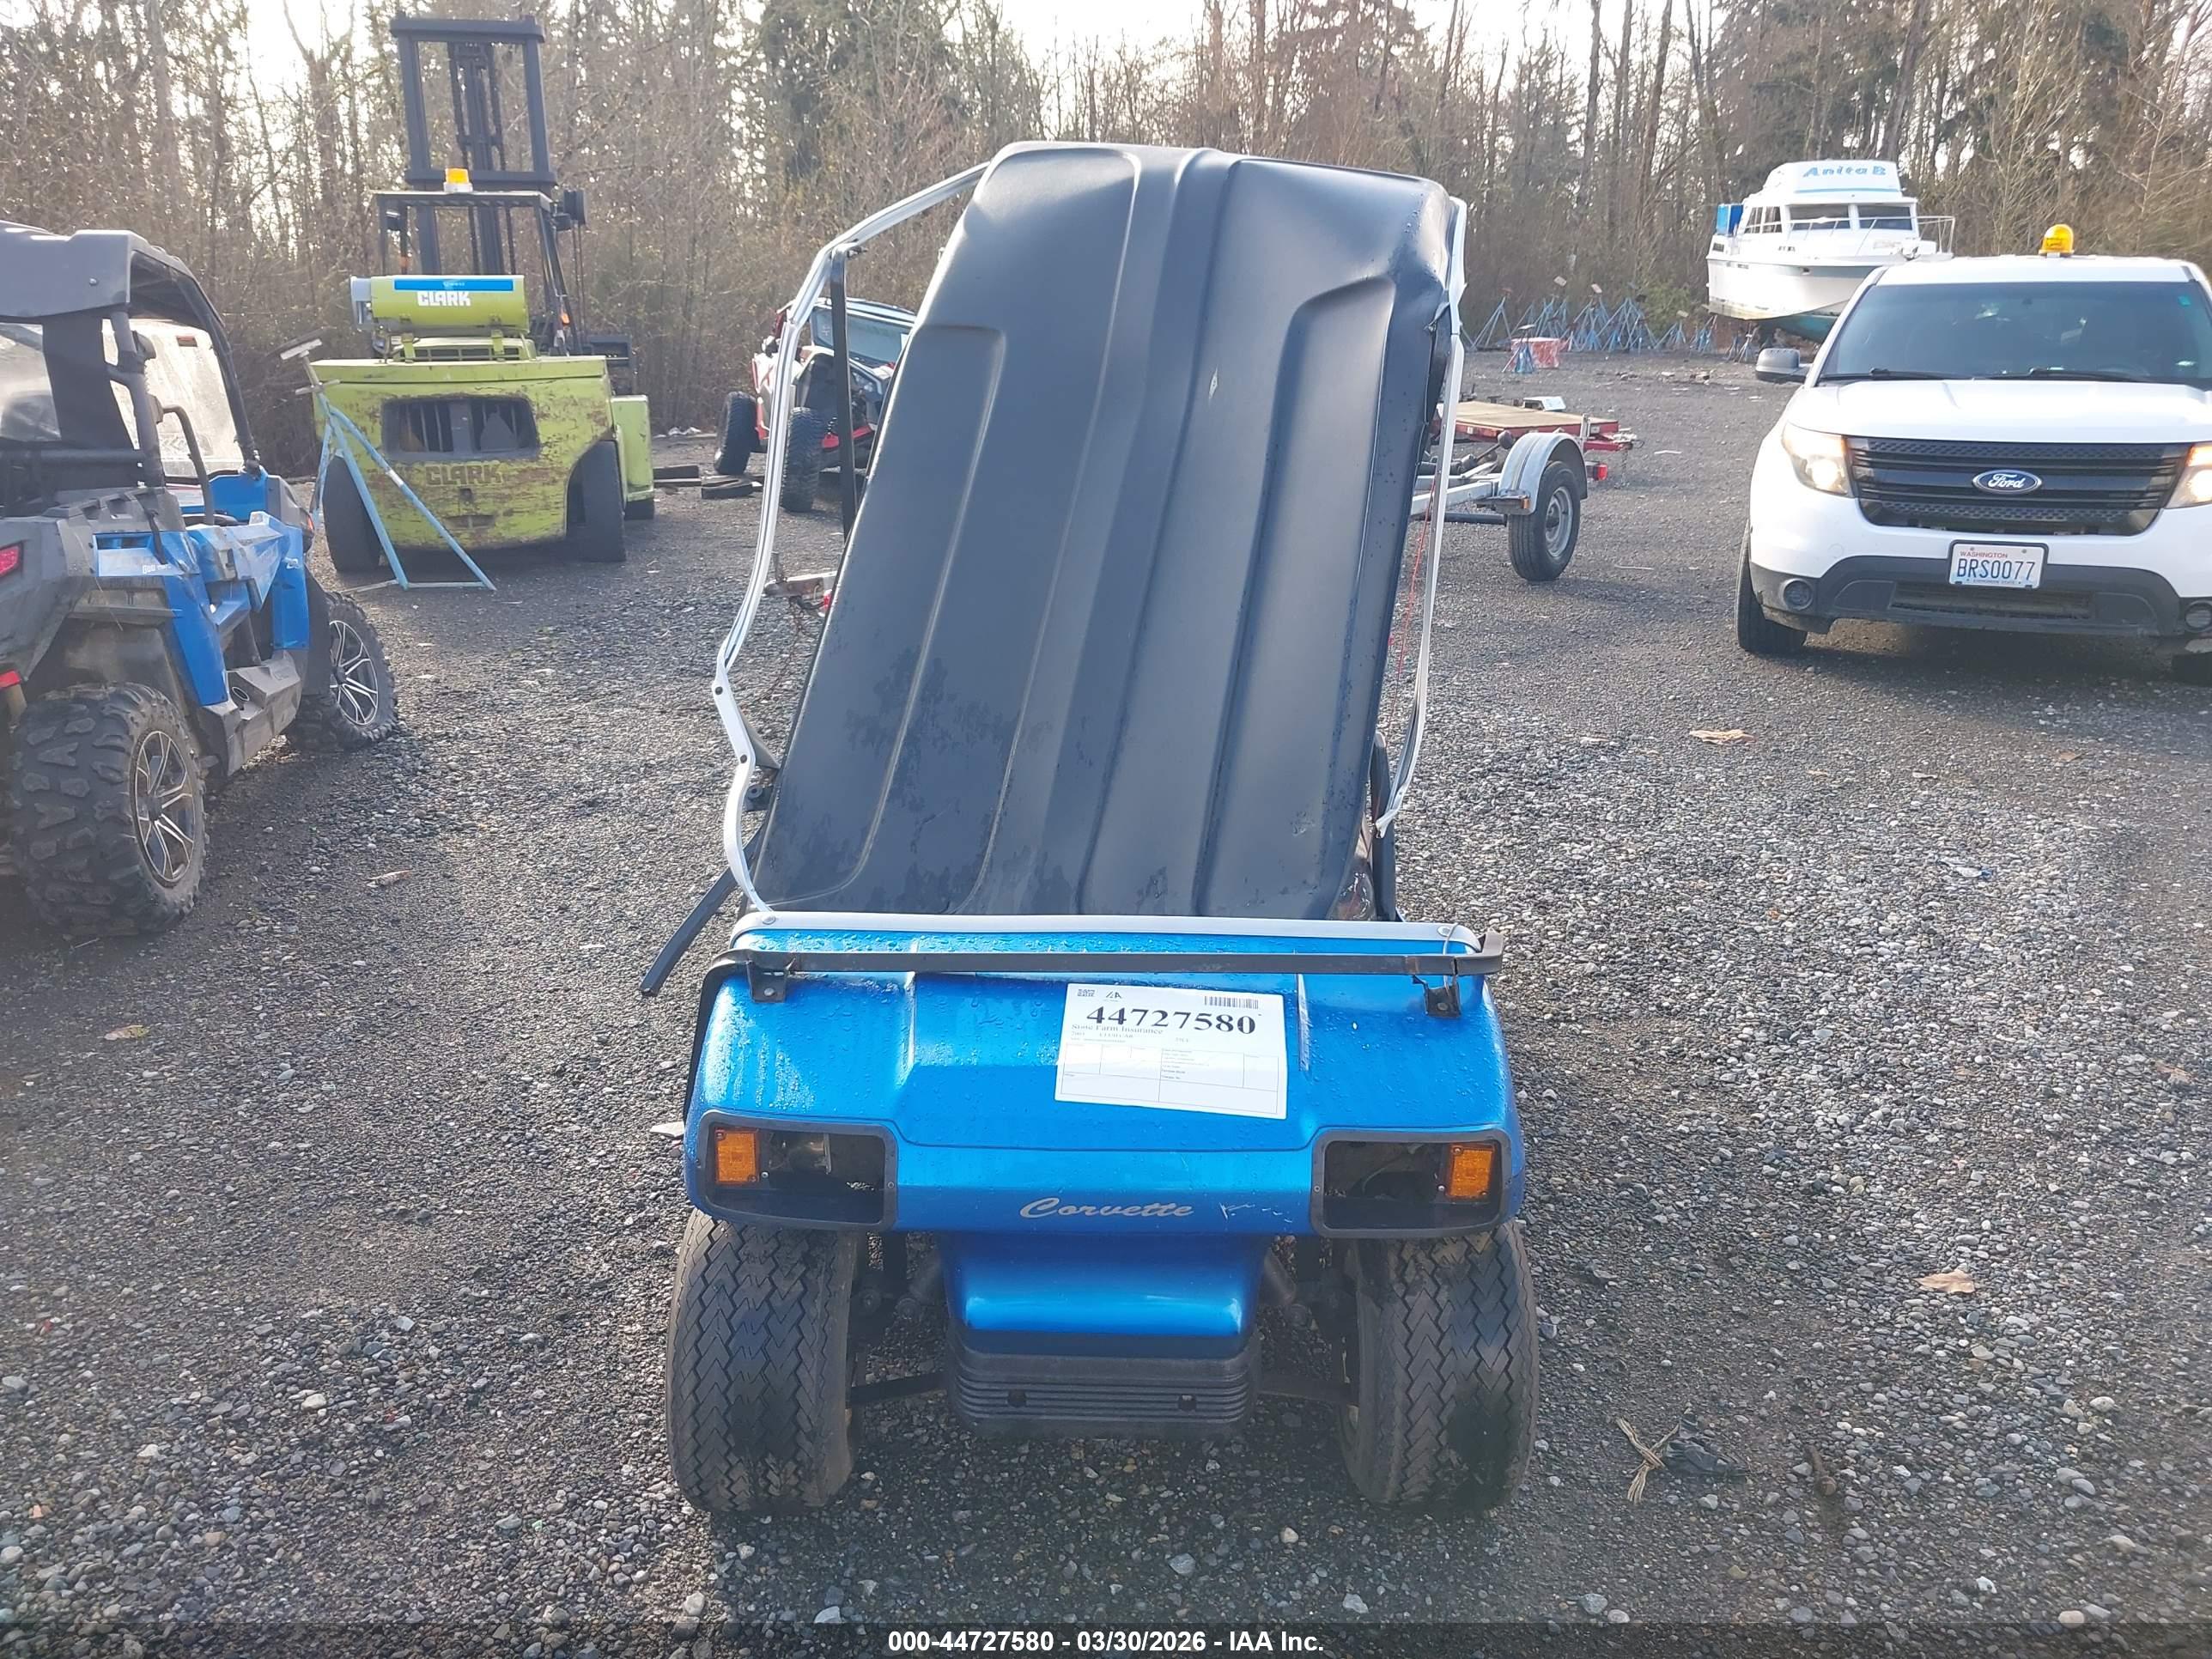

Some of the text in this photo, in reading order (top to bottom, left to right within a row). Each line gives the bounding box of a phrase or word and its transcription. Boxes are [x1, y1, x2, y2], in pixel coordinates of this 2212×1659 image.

[1803, 166, 1887, 177] Anita B
[417, 291, 471, 307] CLARK
[425, 465, 503, 485] CLARK
[1988, 473, 2026, 489] Ford
[1957, 558, 2035, 580] BRS0077
[1086, 1006, 1256, 1035] 44727580
[1121, 1025, 1164, 1035] Insurance
[1020, 1197, 1194, 1218] Corvette
